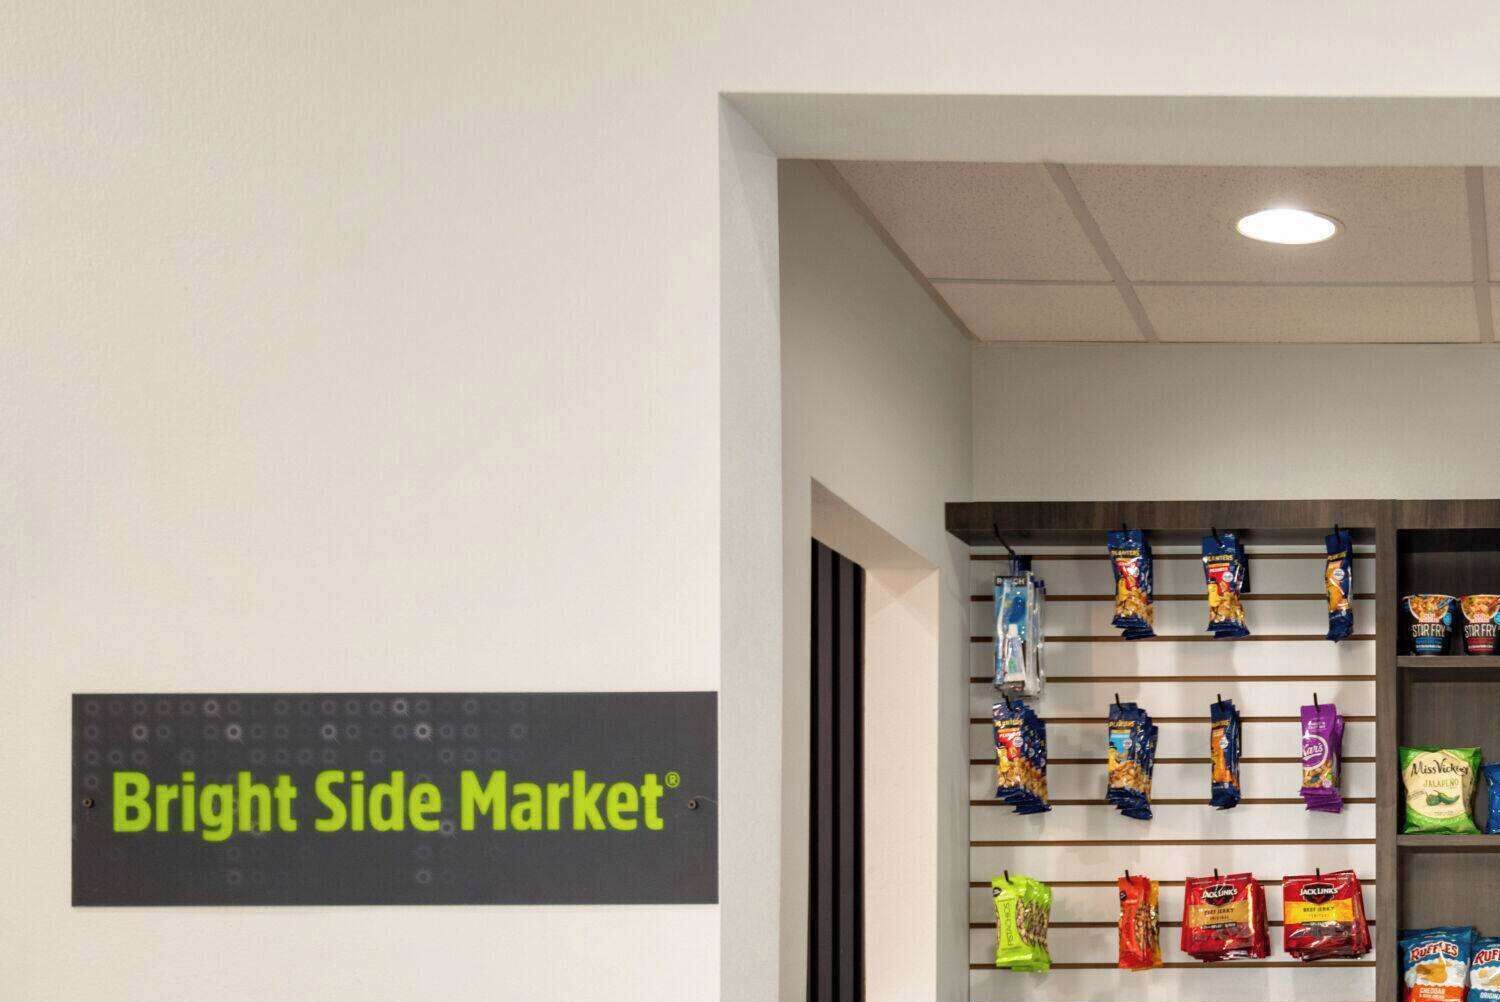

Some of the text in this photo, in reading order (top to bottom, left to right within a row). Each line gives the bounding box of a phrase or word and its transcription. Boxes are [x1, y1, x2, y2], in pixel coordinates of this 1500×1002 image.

[1430, 624, 1445, 638] FRY
[1482, 624, 1497, 638] FRY
[1411, 761, 1437, 777] Miss
[112, 771, 298, 842] Bright
[314, 769, 442, 833] Side
[1202, 889, 1218, 899] JACK
[1300, 887, 1338, 896] JACK LINK'S
[1410, 941, 1459, 963] RUFFLES
